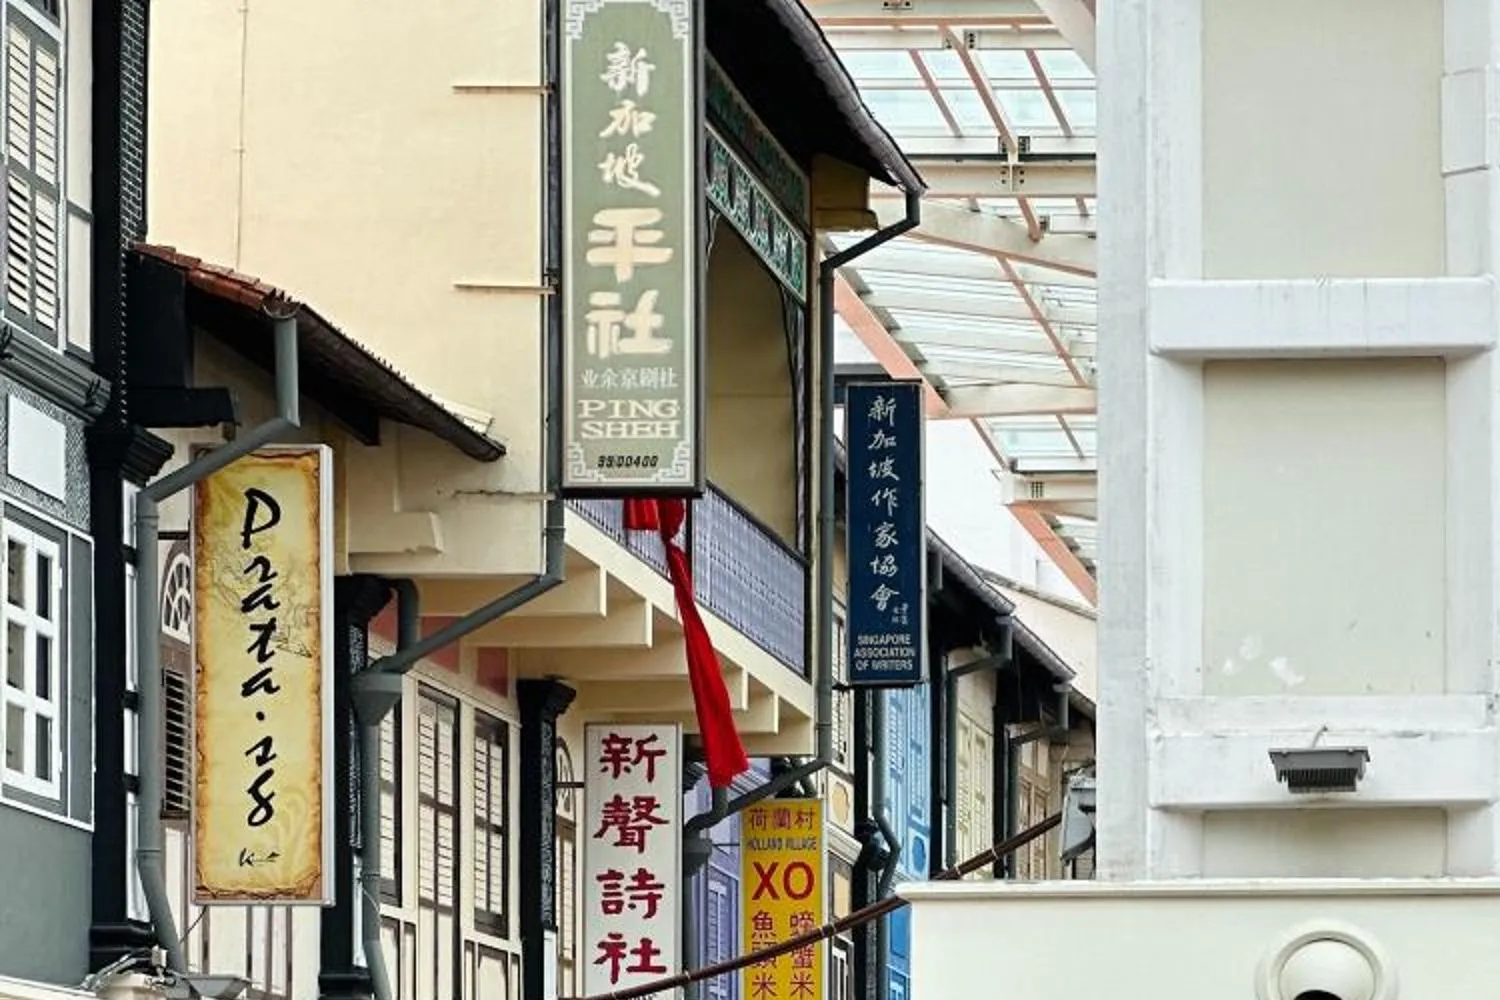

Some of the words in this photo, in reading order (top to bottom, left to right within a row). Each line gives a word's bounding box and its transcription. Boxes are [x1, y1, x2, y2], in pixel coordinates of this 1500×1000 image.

[577, 399, 680, 419] PING
[580, 420, 681, 440] SHEH
[868, 395, 900, 612] 新加坡作家協會
[857, 633, 911, 646] SINGAPORE
[853, 647, 917, 659] ASSOCIATION
[855, 660, 869, 671] OF
[871, 660, 913, 671] WRITERS
[593, 733, 669, 985] 新聲詩社
[752, 860, 816, 901] XO
